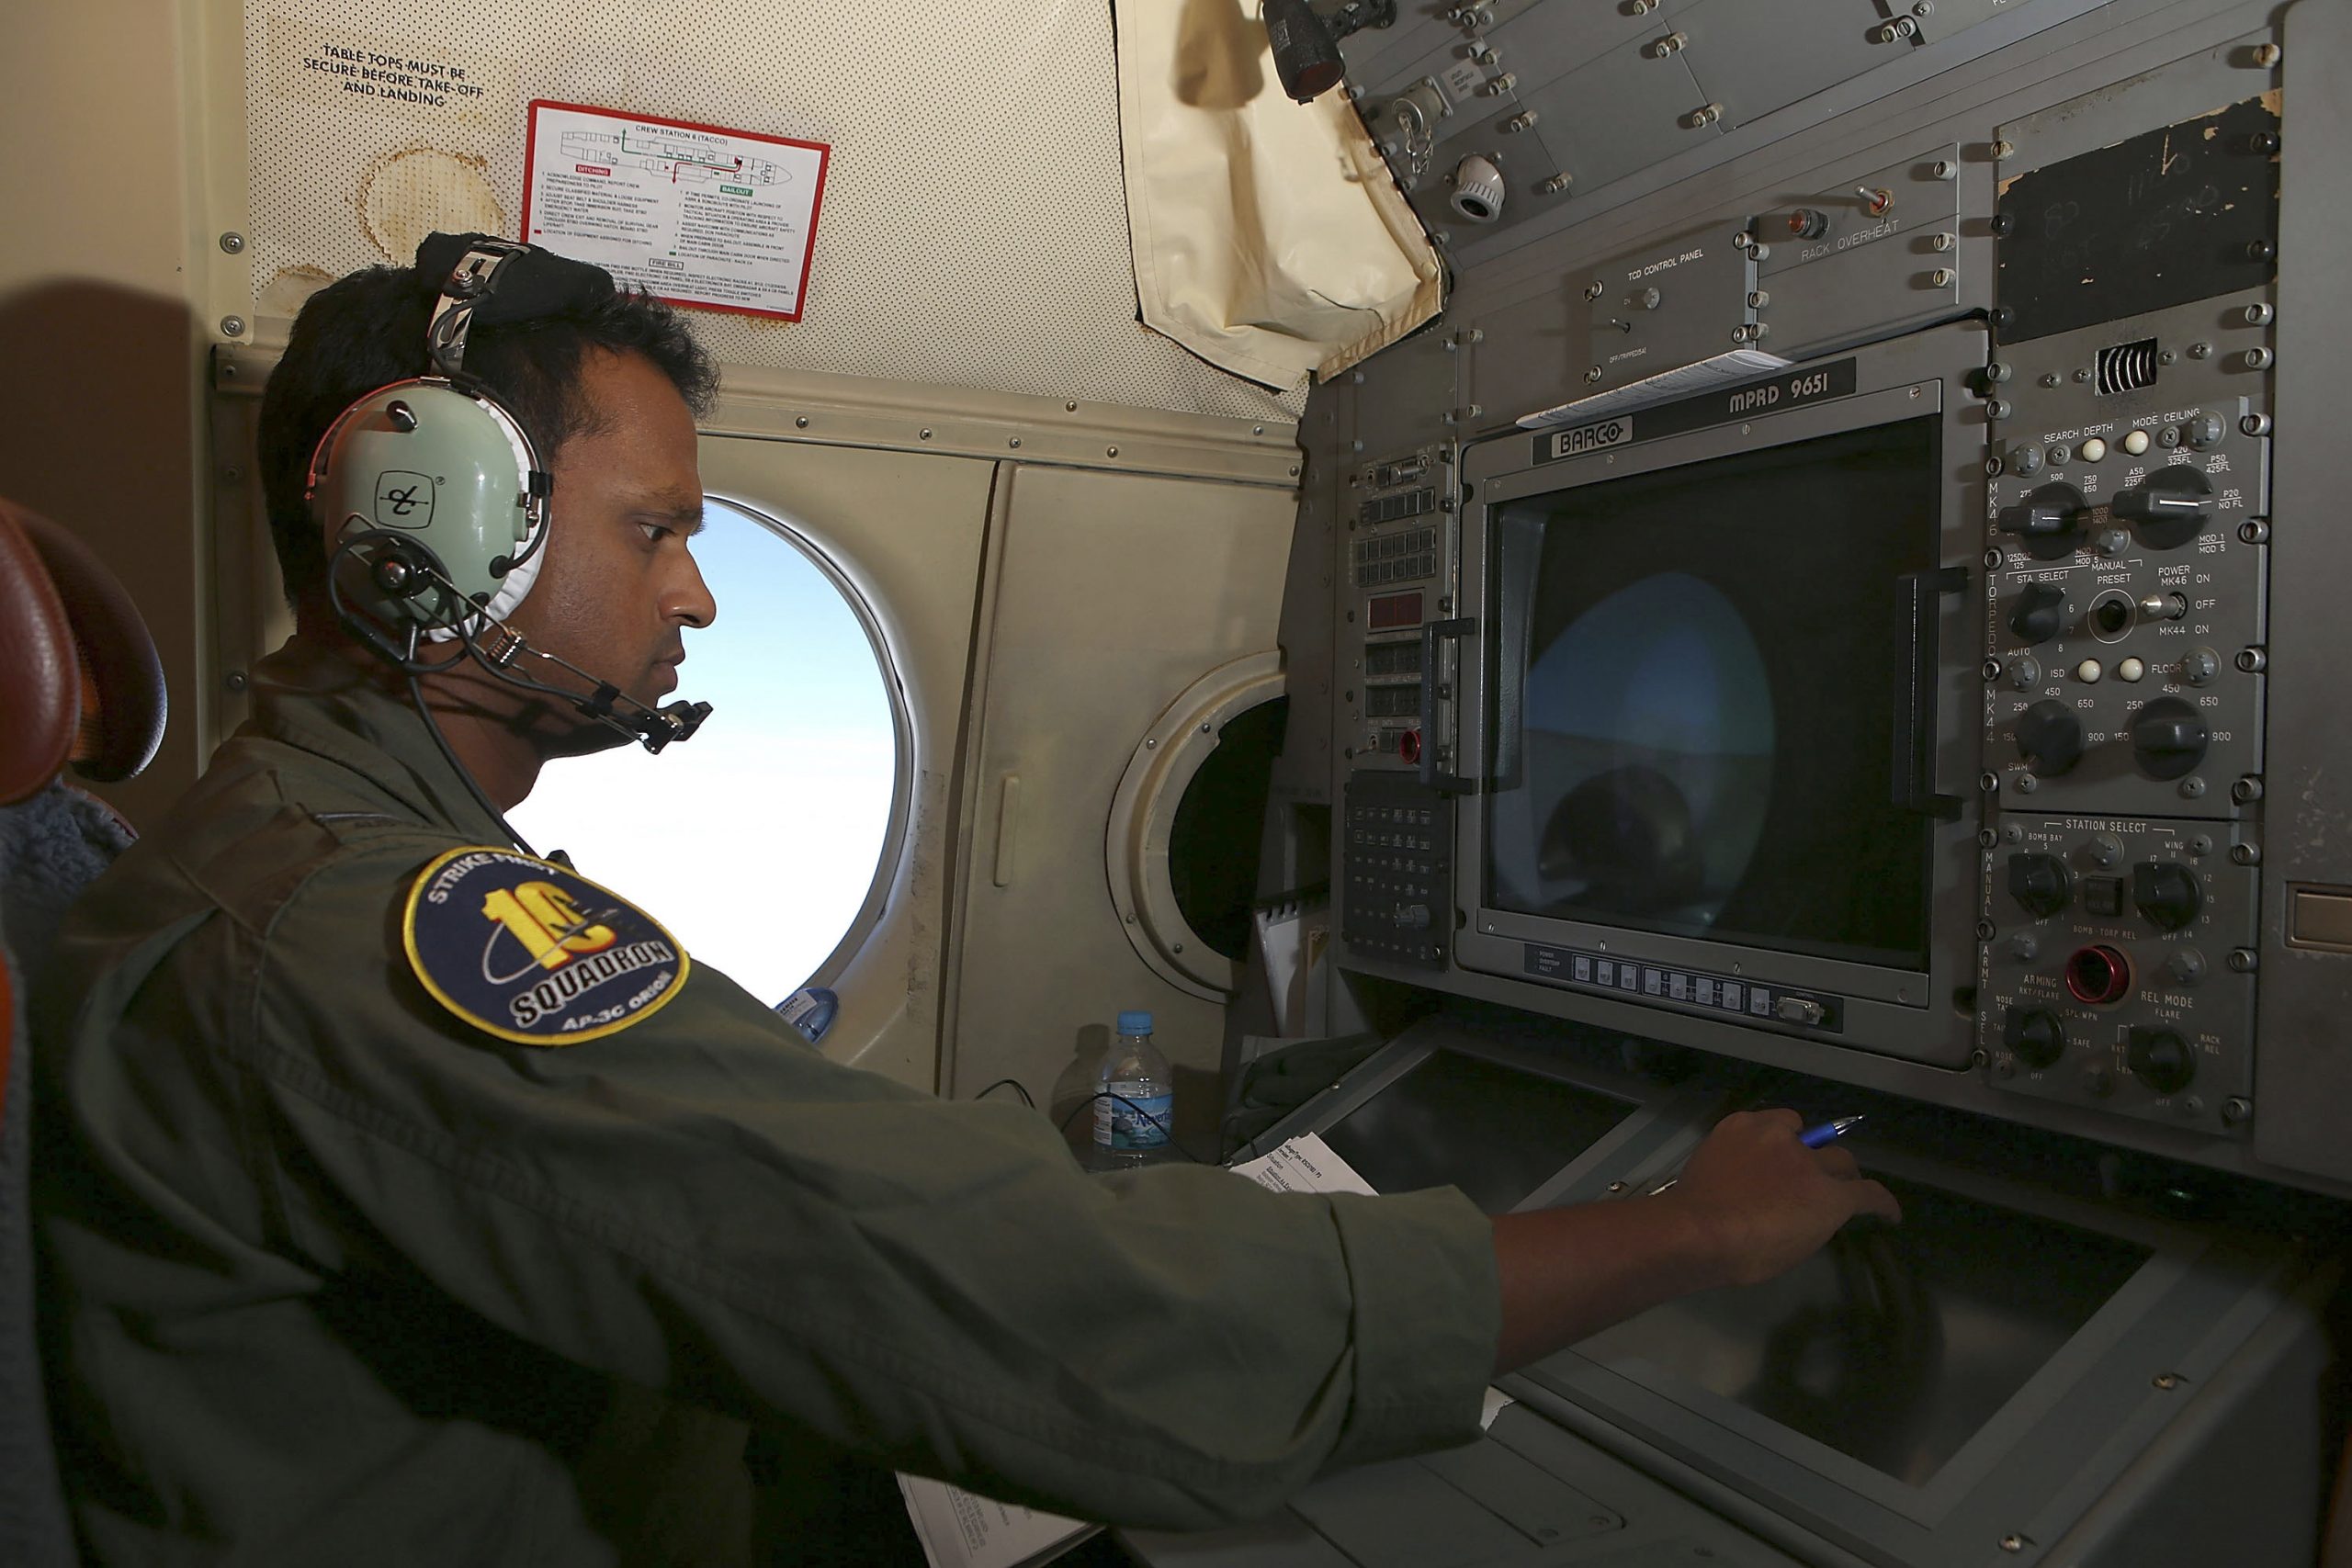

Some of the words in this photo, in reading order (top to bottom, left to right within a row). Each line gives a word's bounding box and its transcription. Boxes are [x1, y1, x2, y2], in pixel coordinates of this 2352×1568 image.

[323, 45, 364, 62] TABLE
[368, 52, 402, 70] TOPS
[408, 59, 445, 76] MUST
[450, 67, 465, 79] BE
[303, 57, 357, 76] SECURE
[362, 65, 413, 86] BEFORE
[418, 77, 484, 99] TAKE-OFF
[344, 81, 375, 96] AND
[380, 87, 445, 107] LANDING
[635, 125, 657, 134] CREW
[660, 129, 690, 140] STATION
[697, 134, 728, 146] (TACCO)
[578, 166, 609, 175] DITCHING
[722, 186, 749, 196] BAILOUT
[1802, 242, 1830, 262] RACK
[1838, 220, 1900, 250] OVERHEAT
[1628, 270, 1642, 281] TCD
[1644, 258, 1677, 276] CONTROL
[1679, 249, 1703, 264] PANEL
[1729, 385, 1780, 413] MPRD
[1791, 372, 1828, 399] 9651
[2132, 415, 2158, 428] MODE
[2164, 408, 2200, 422] CEILING
[1560, 421, 1623, 454] BARCO
[2044, 430, 2079, 443] SEARCH
[2084, 423, 2113, 436] DEPTH
[2168, 457, 2192, 466] 325FL
[2211, 454, 2226, 463] P50
[2129, 467, 2143, 476] A50
[2206, 464, 2231, 474] 425FL
[2051, 473, 2064, 481] 500
[2084, 475, 2098, 483] 750
[2020, 489, 2033, 498] 275
[2223, 489, 2239, 497] P20
[2218, 500, 2230, 509] NO
[2233, 498, 2244, 507] FL
[1989, 482, 1998, 536] MK46
[2199, 534, 2217, 543] MOD
[2199, 545, 2217, 554] MOD
[2221, 544, 2225, 552] 5
[2075, 557, 2091, 566] MOD
[2094, 556, 2099, 564] 5
[2091, 561, 2126, 571] MANUAL
[2158, 565, 2190, 576] POWER
[2017, 575, 2033, 584] STA
[2039, 570, 2069, 582] SELECT
[2097, 573, 2132, 585] PRESET
[2161, 575, 2188, 586] MK46
[2196, 574, 2211, 584] ON
[2069, 604, 2075, 613] 6
[2196, 599, 2216, 610] OFF
[1988, 574, 1997, 657] TORPEDO
[2159, 626, 2186, 636] MK44
[2195, 625, 2210, 635] ON
[2007, 648, 2030, 657] AUTO
[2058, 644, 2064, 652] 8
[2152, 664, 2182, 673] FLOOR
[2045, 687, 2061, 696] 450
[2162, 683, 2180, 694] 450
[2077, 699, 2094, 708] 650
[2126, 700, 2143, 710] 250
[2199, 696, 2219, 706] 650
[2013, 703, 2028, 712] 250
[1986, 689, 1996, 744] MK44
[2088, 732, 2105, 742] 900
[2114, 732, 2130, 741] 150
[2212, 731, 2231, 741] 900
[2066, 819, 2105, 831] STATION
[2109, 822, 2147, 833] SELECT
[2029, 832, 2048, 841] BOMB
[2050, 834, 2063, 842] BAY
[2043, 842, 2049, 851] 5
[2165, 840, 2184, 850] WING
[427, 852, 494, 904] STRIKE
[2204, 874, 2212, 883] 12
[1984, 852, 1993, 917] MANUAL
[2074, 925, 2093, 935] BOMB
[2184, 931, 2193, 939] 14
[2162, 932, 2177, 942] OFF
[1981, 945, 1989, 989] ARMT
[509, 941, 675, 1029] SQUADRON
[2024, 974, 2057, 988] ARMING
[628, 970, 673, 1010] ORION
[1996, 995, 2014, 1005] NOSE
[2141, 990, 2159, 1004] REL
[2165, 994, 2194, 1009] MODE
[2154, 1008, 2181, 1020] FLARE
[2073, 1038, 2090, 1048] SAFE
